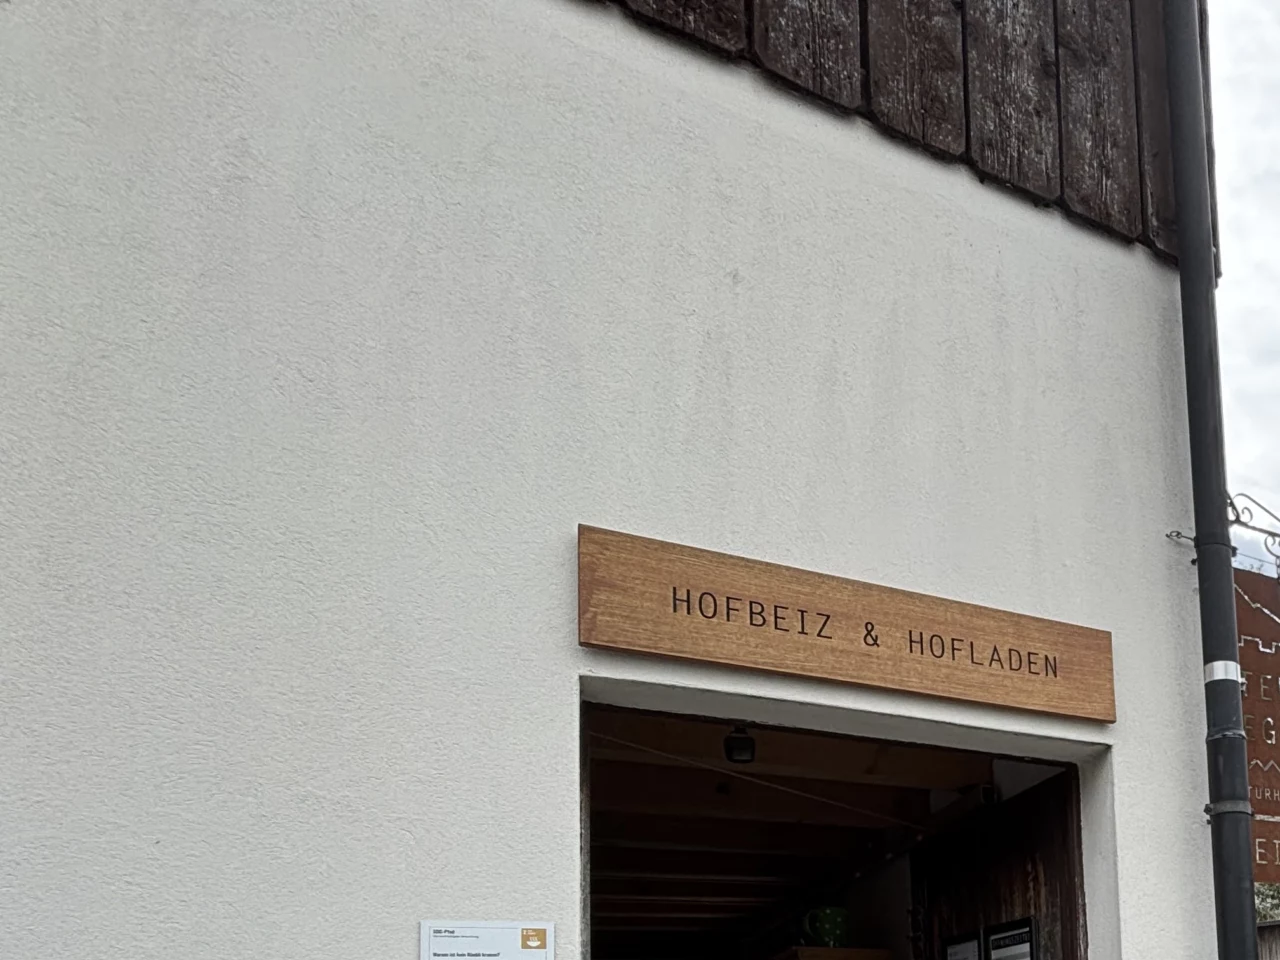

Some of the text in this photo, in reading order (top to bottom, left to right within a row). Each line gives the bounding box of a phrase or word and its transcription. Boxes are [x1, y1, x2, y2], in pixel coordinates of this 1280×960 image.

[671, 585, 1060, 679] HOFBEIZ & HOFLADEN
